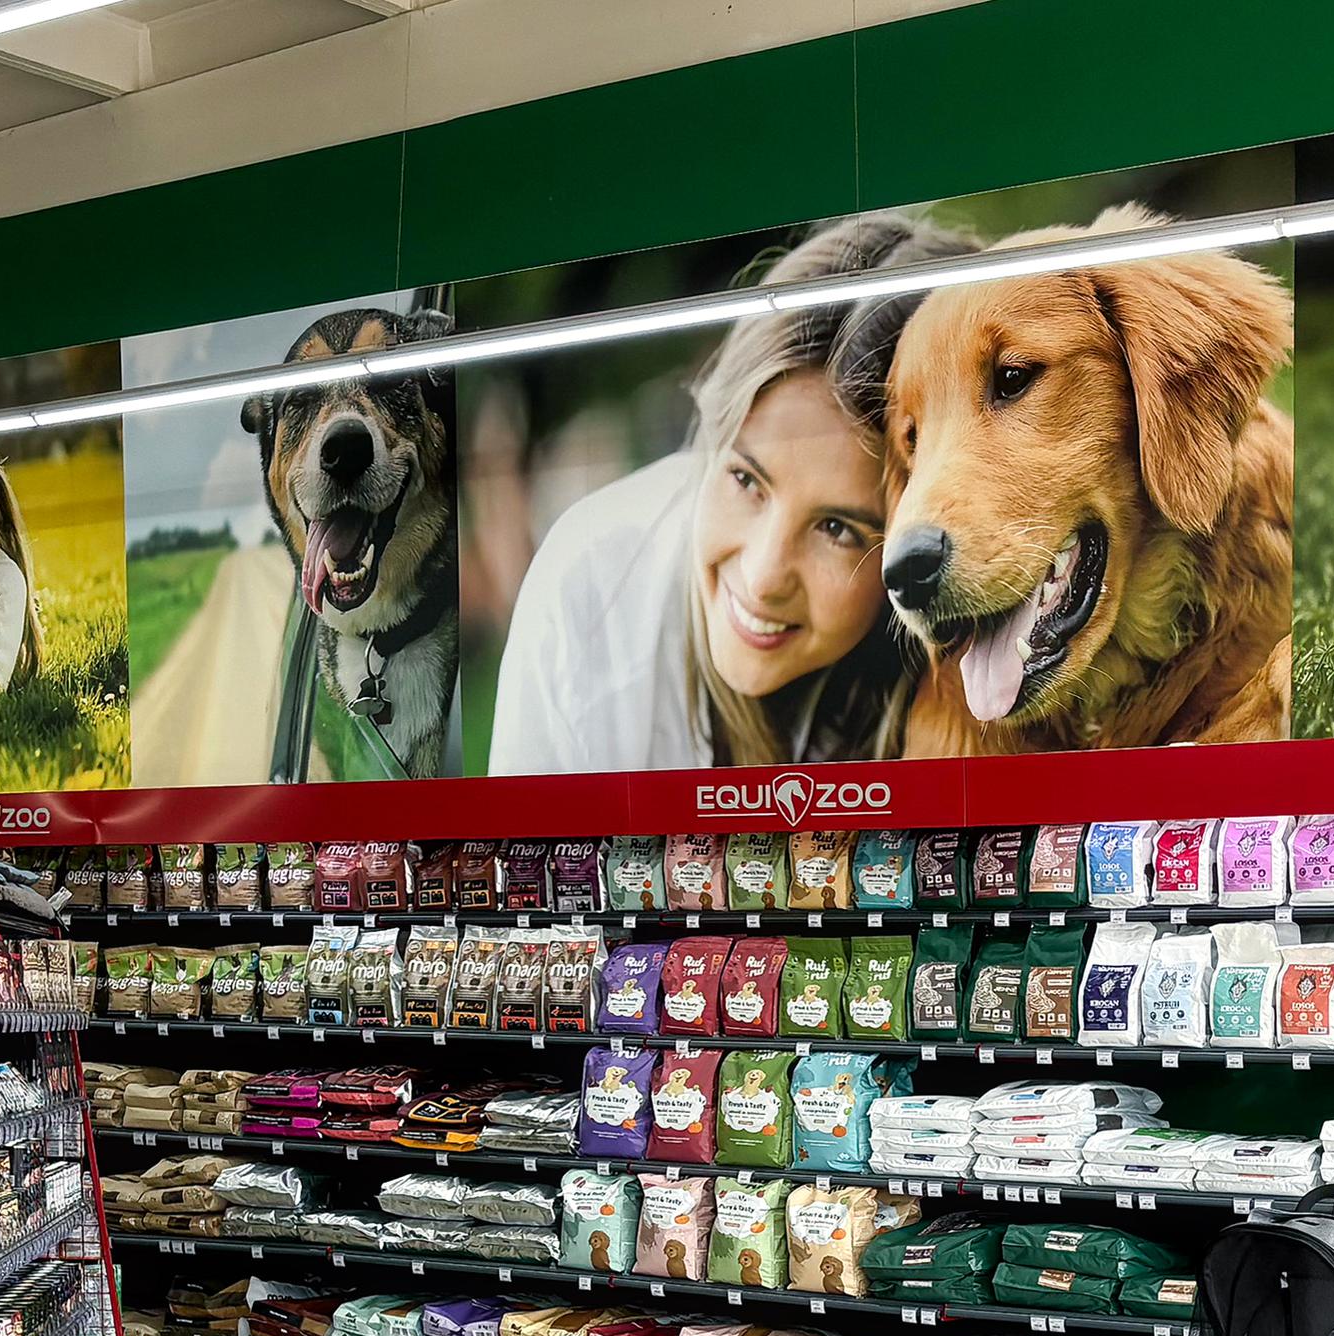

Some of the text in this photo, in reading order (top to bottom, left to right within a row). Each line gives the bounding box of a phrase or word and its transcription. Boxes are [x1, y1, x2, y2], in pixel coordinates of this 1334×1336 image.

[697, 783, 891, 810] EQUI ZOO
[2, 808, 50, 827] ZOO
[365, 842, 400, 855] marp
[555, 842, 593, 859] marp
[1304, 856, 1329, 864] LOSOS
[309, 958, 345, 975] marp
[408, 959, 446, 978] marp
[460, 959, 495, 976] marp
[683, 957, 704, 969] Ruf
[688, 965, 706, 976] ruf
[805, 960, 826, 973] Ruf
[869, 960, 891, 973] Ruf
[353, 963, 385, 980] marp
[506, 962, 541, 980] marp
[550, 962, 588, 980] marp
[810, 970, 830, 980] ruf
[873, 970, 893, 980] ruf
[1291, 1002, 1316, 1010] LOSOS
